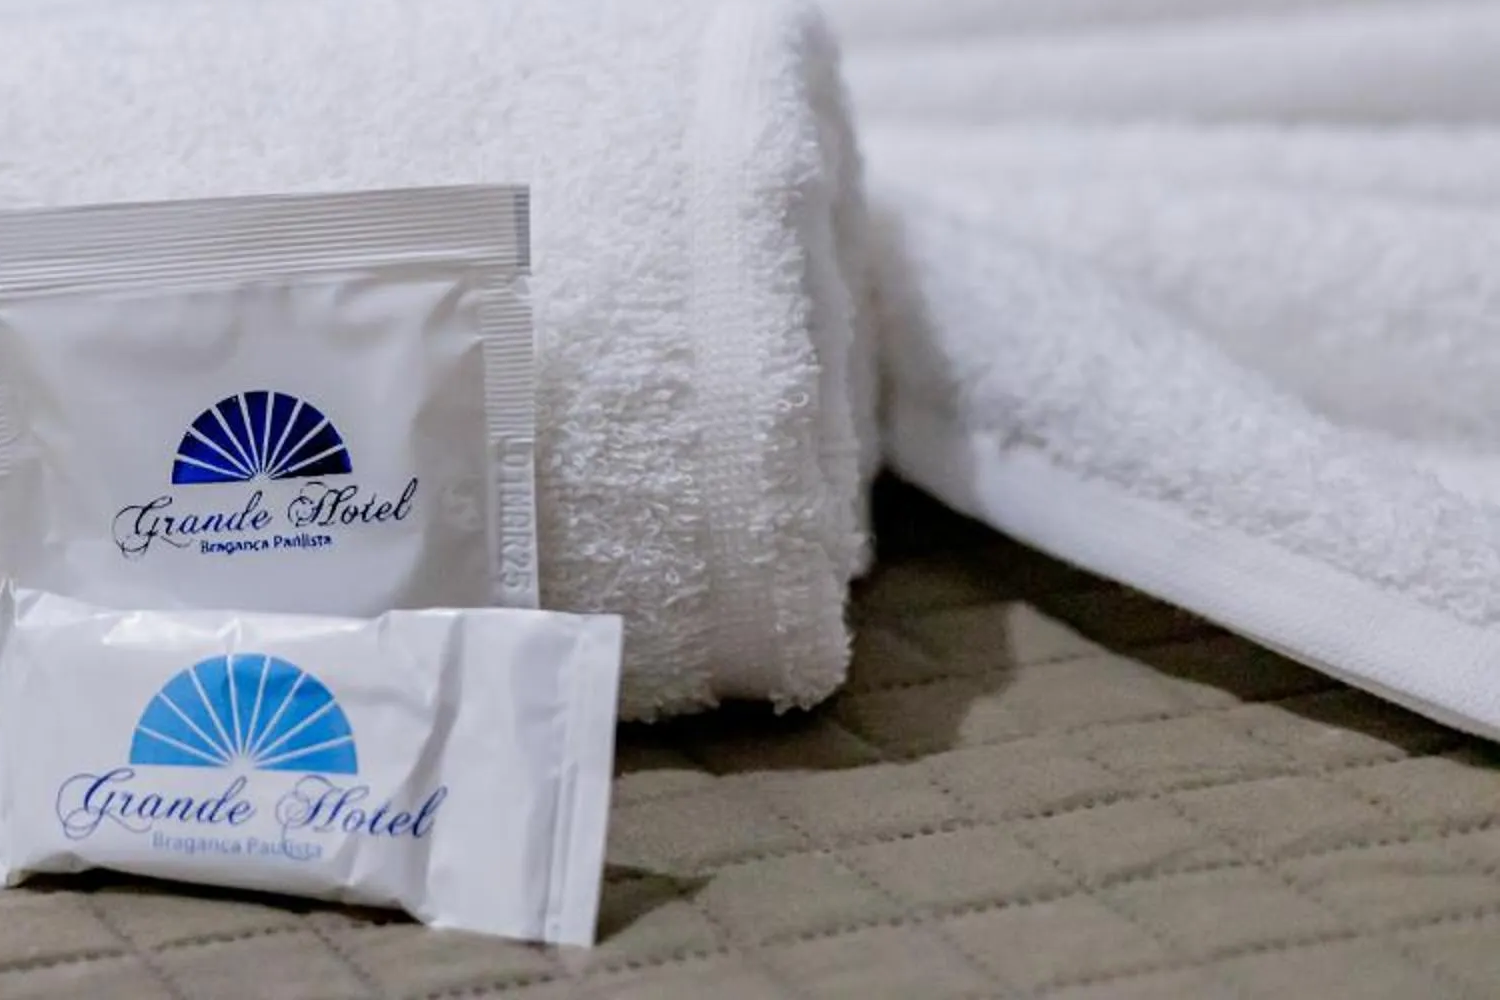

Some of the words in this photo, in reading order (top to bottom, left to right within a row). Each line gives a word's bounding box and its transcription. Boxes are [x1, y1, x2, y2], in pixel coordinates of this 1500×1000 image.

[111, 490, 273, 558] Grande
[287, 477, 418, 528] Hotel
[56, 767, 255, 841] Grande
[275, 774, 448, 859] Hotel
[247, 837, 323, 859] Paulista
